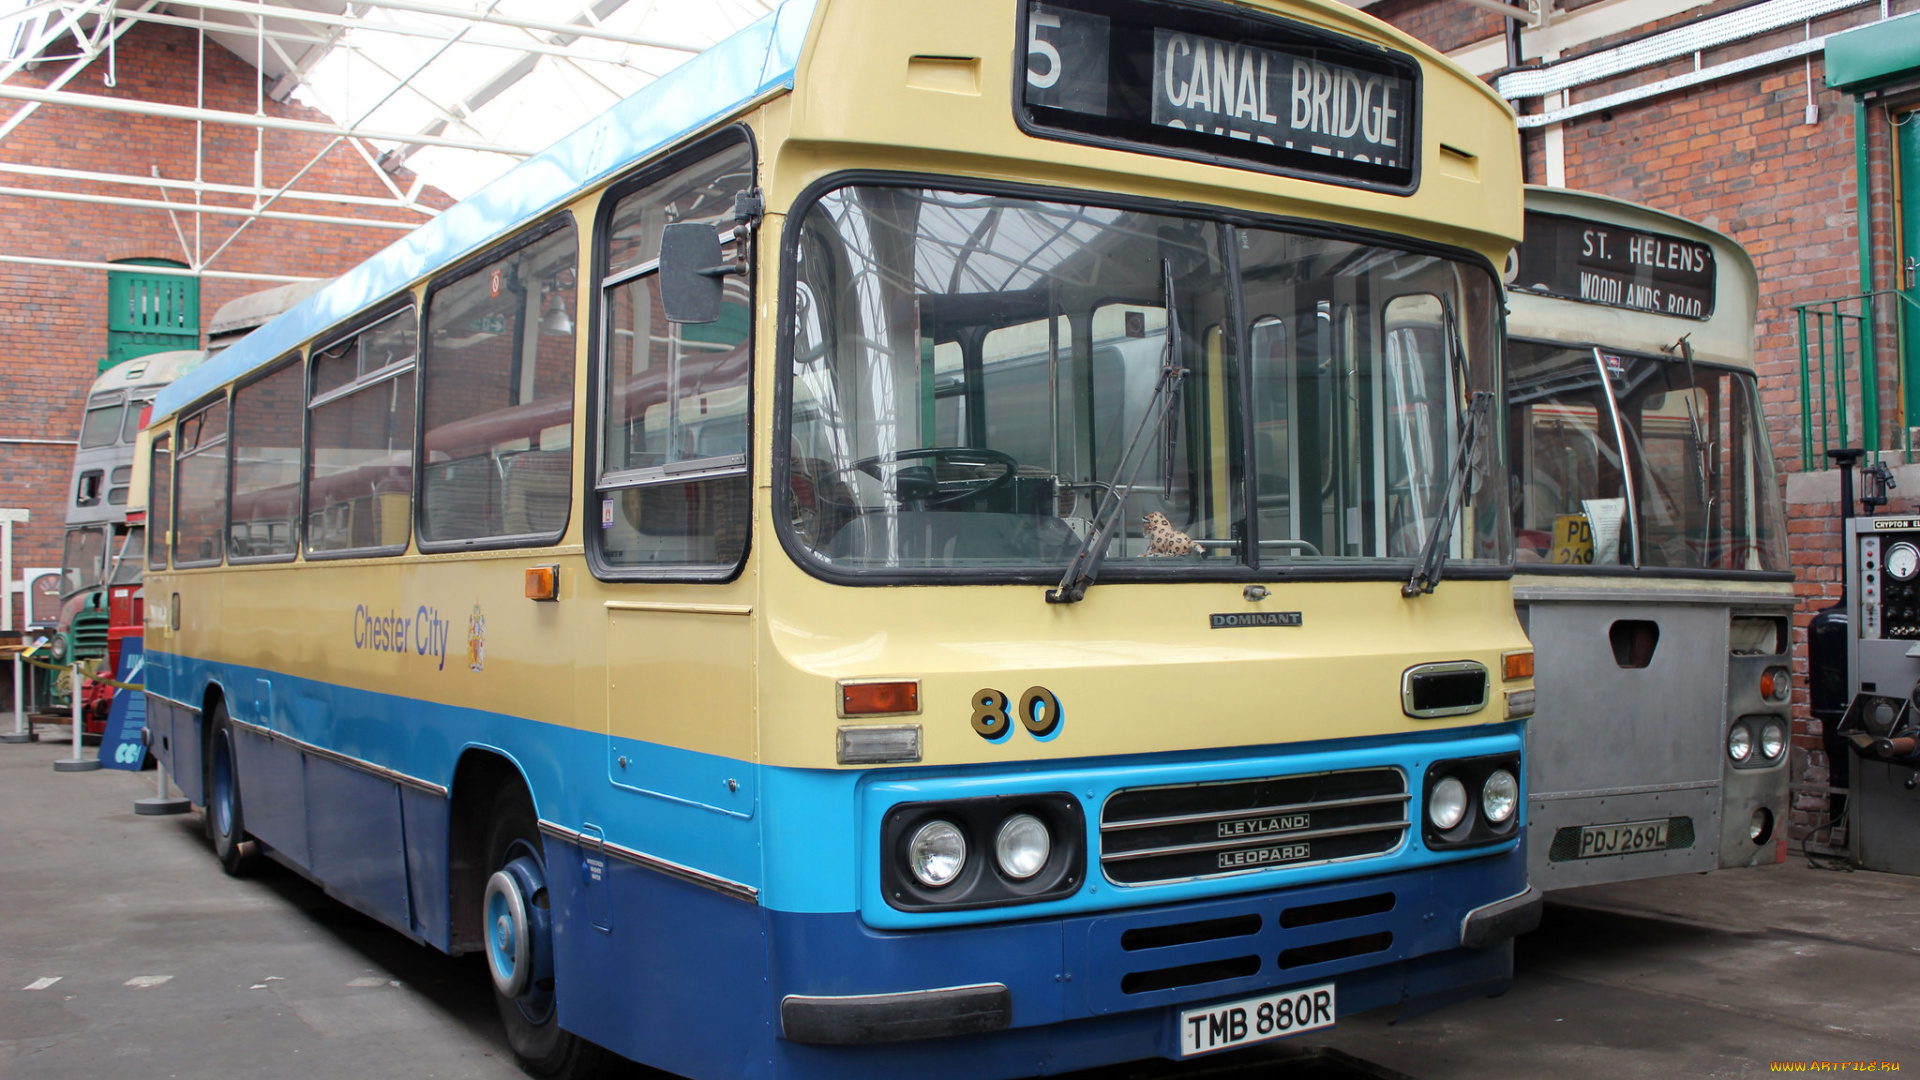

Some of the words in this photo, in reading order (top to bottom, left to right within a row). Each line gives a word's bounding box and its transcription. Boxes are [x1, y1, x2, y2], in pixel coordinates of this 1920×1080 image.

[1165, 33, 1278, 126] CANAL
[1291, 58, 1400, 148] BRIDGE
[1582, 229, 1612, 261] ST.
[1580, 271, 1661, 311] WOODLANDS
[1668, 293, 1702, 317] ROAD
[1875, 520, 1909, 528] CRYPTON
[354, 603, 411, 654] Chester
[415, 604, 449, 672] City
[1212, 613, 1300, 627] DOMINANT
[970, 685, 1065, 746] 80
[1224, 815, 1305, 835] LEYLAND
[1224, 845, 1306, 866] LEOPARD
[1188, 1007, 1248, 1050] TMB
[1256, 990, 1331, 1035] 880R
